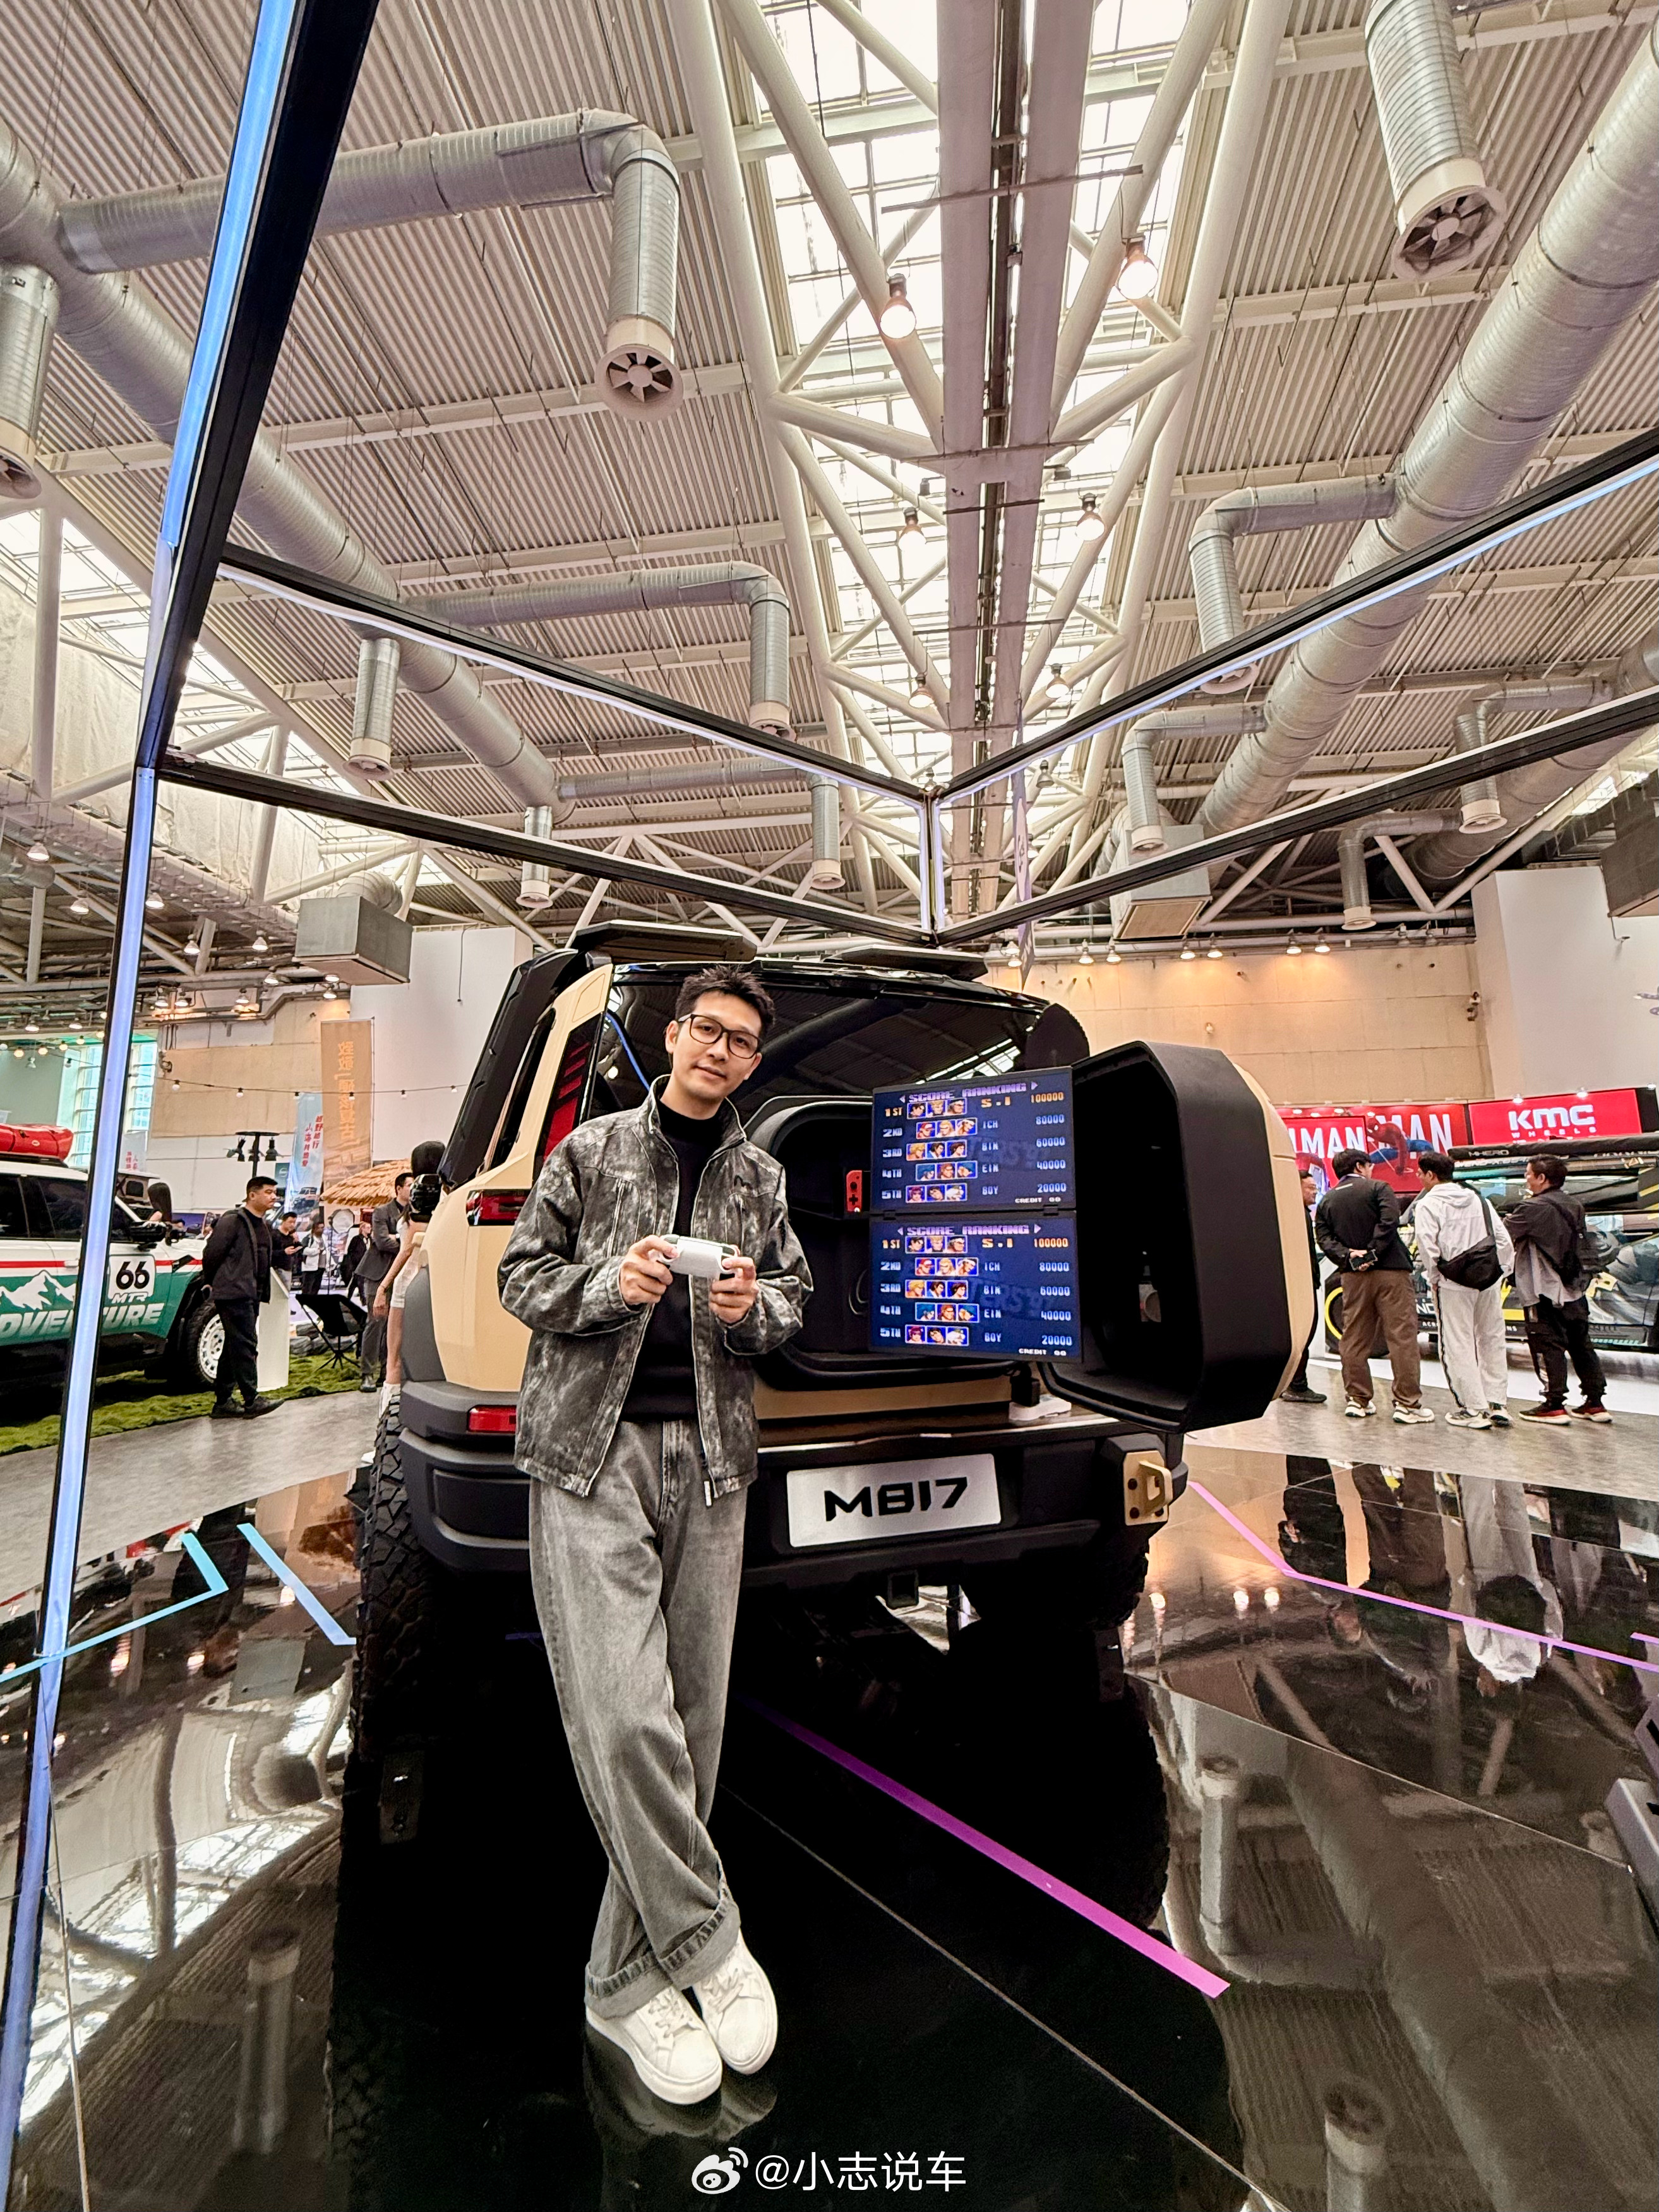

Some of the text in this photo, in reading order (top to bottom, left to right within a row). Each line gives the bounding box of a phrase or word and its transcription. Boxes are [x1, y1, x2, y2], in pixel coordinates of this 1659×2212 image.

[908, 1083, 1027, 1103] SCORE RANKING
[1031, 1092, 1064, 1103] 100000
[1036, 1114, 1065, 1125] 80000
[1036, 1137, 1065, 1147] 60000
[1036, 1159, 1066, 1170] 40000
[882, 1183, 1067, 1199] 5TH BOY 20000
[907, 1224, 1029, 1236] SCORE RANKING
[1034, 1238, 1069, 1248] 100000
[1039, 1262, 1070, 1272] 80000
[116, 1261, 150, 1290] 66
[1040, 1286, 1070, 1296] 60000
[111, 1292, 148, 1303] MTR
[1041, 1310, 1072, 1321] 40000
[880, 1327, 1072, 1346] 5TH BOY 20000
[824, 1476, 968, 1522] M817
